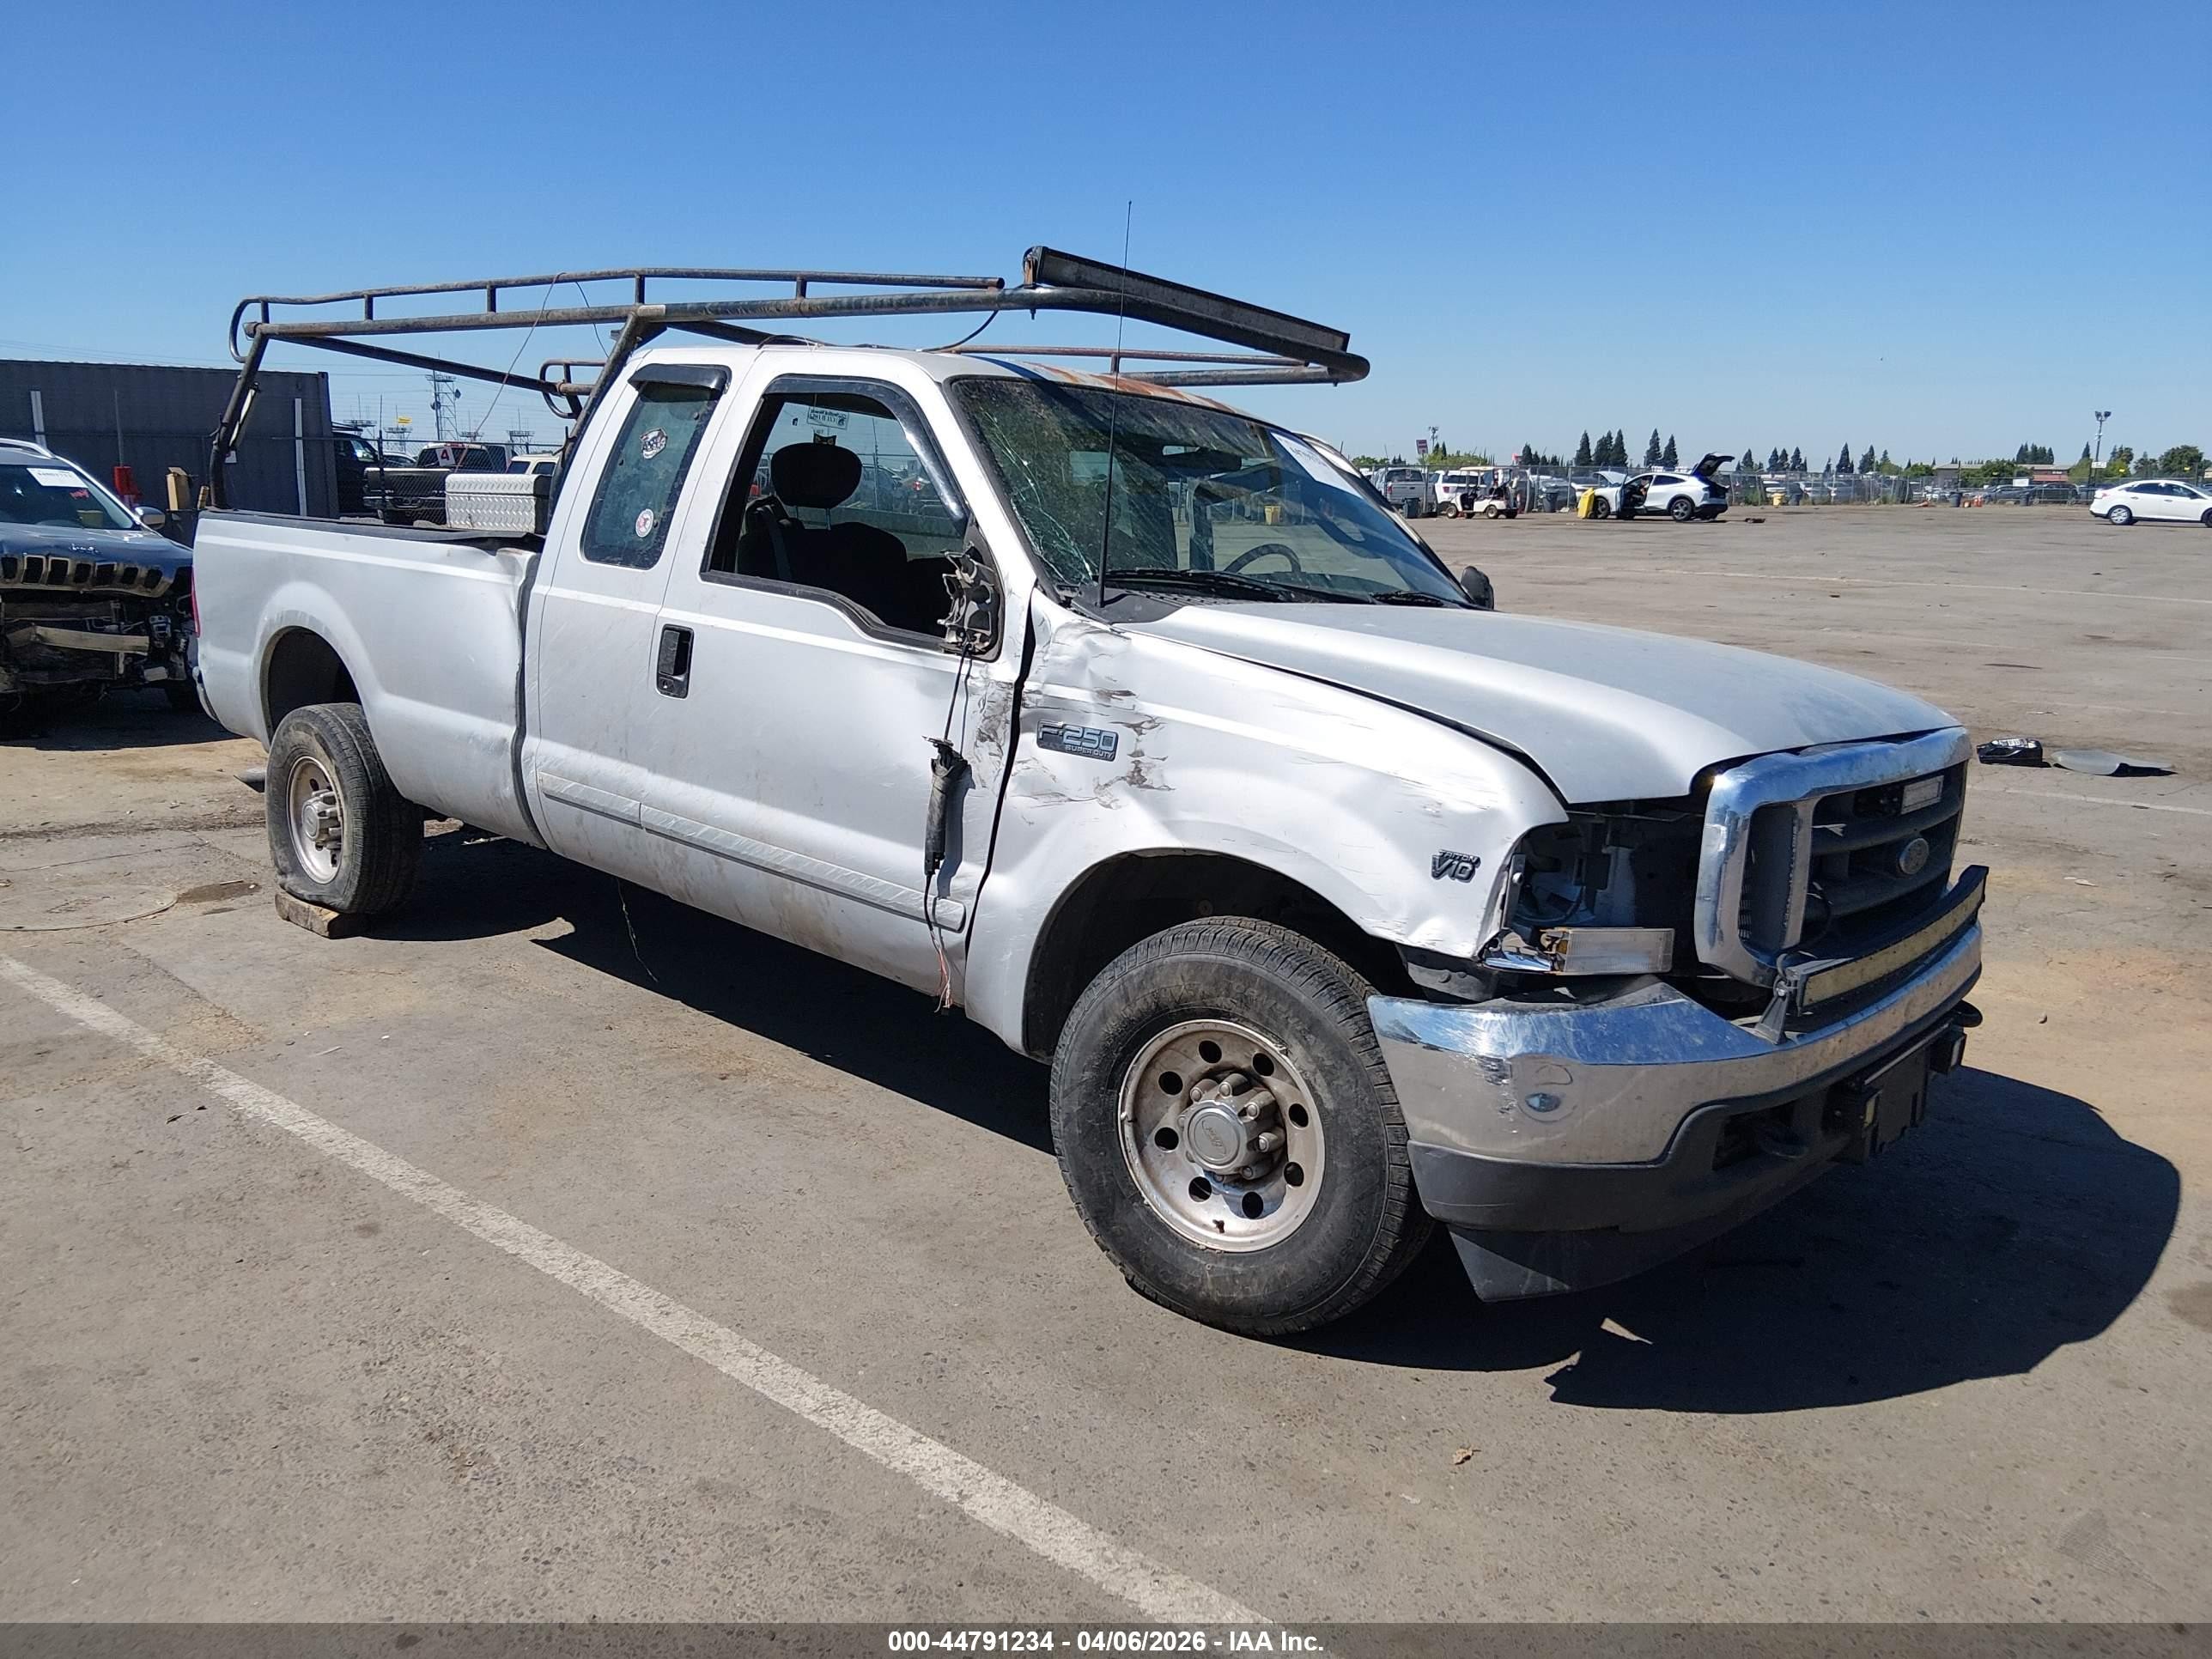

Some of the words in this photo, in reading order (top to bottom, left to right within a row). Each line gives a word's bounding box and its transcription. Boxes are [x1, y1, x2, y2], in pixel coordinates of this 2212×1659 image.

[441, 449, 449, 460] 4
[1038, 721, 1116, 750] F-250
[1065, 744, 1092, 754] SUPER
[1093, 750, 1115, 760] DUTY
[1431, 855, 1474, 881] V10
